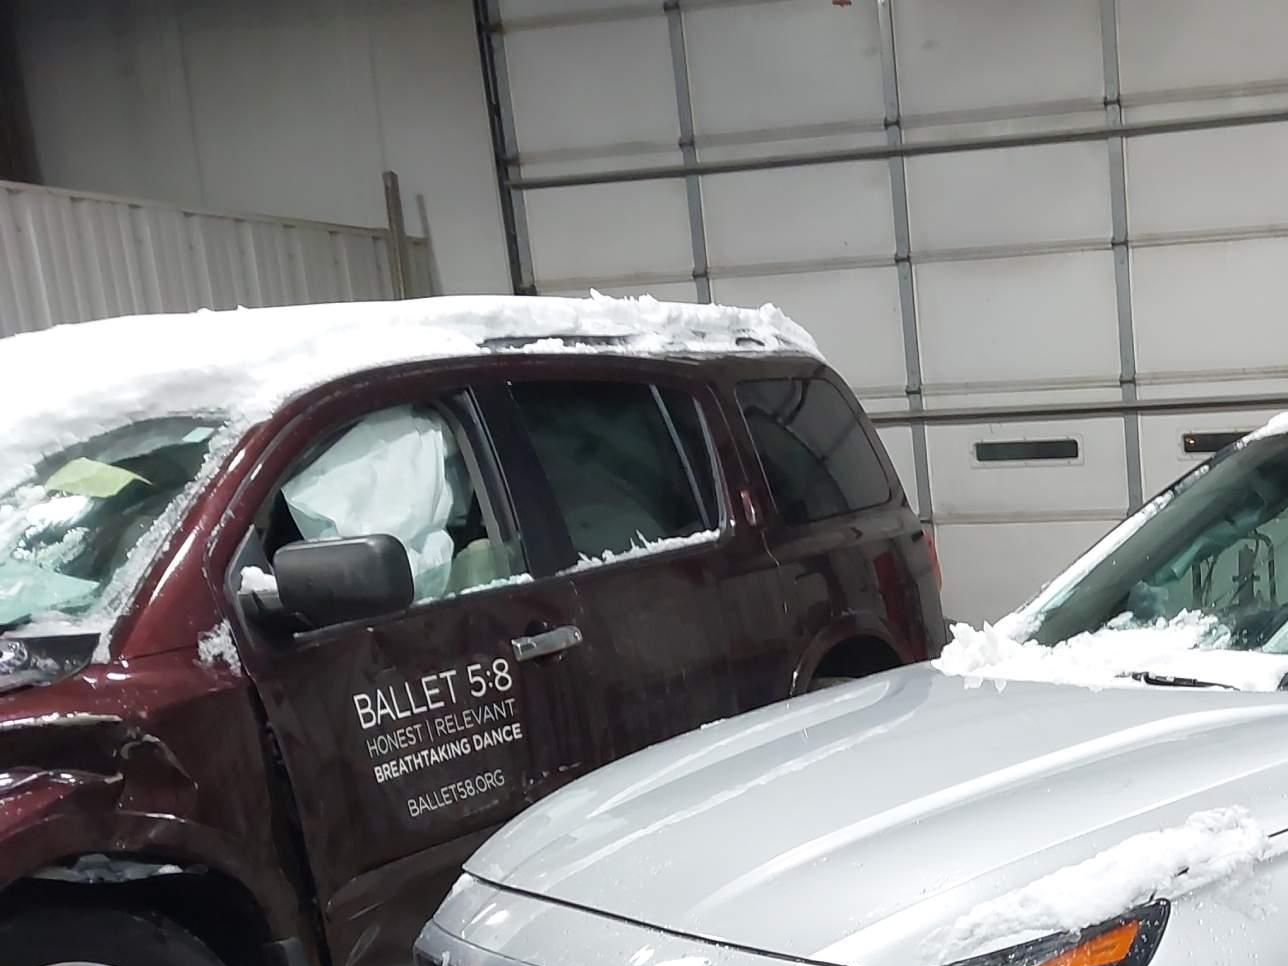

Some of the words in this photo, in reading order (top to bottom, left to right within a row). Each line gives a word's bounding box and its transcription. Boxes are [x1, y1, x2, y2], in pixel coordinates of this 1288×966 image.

[353, 669, 458, 730] BALLET
[466, 658, 514, 698] 5:8
[366, 723, 423, 759] HONEST
[434, 698, 516, 738] RELEVANT
[373, 738, 472, 784] BREATHTAKING
[472, 722, 524, 751] DANCE
[407, 768, 506, 818] BALLET58.ORG
